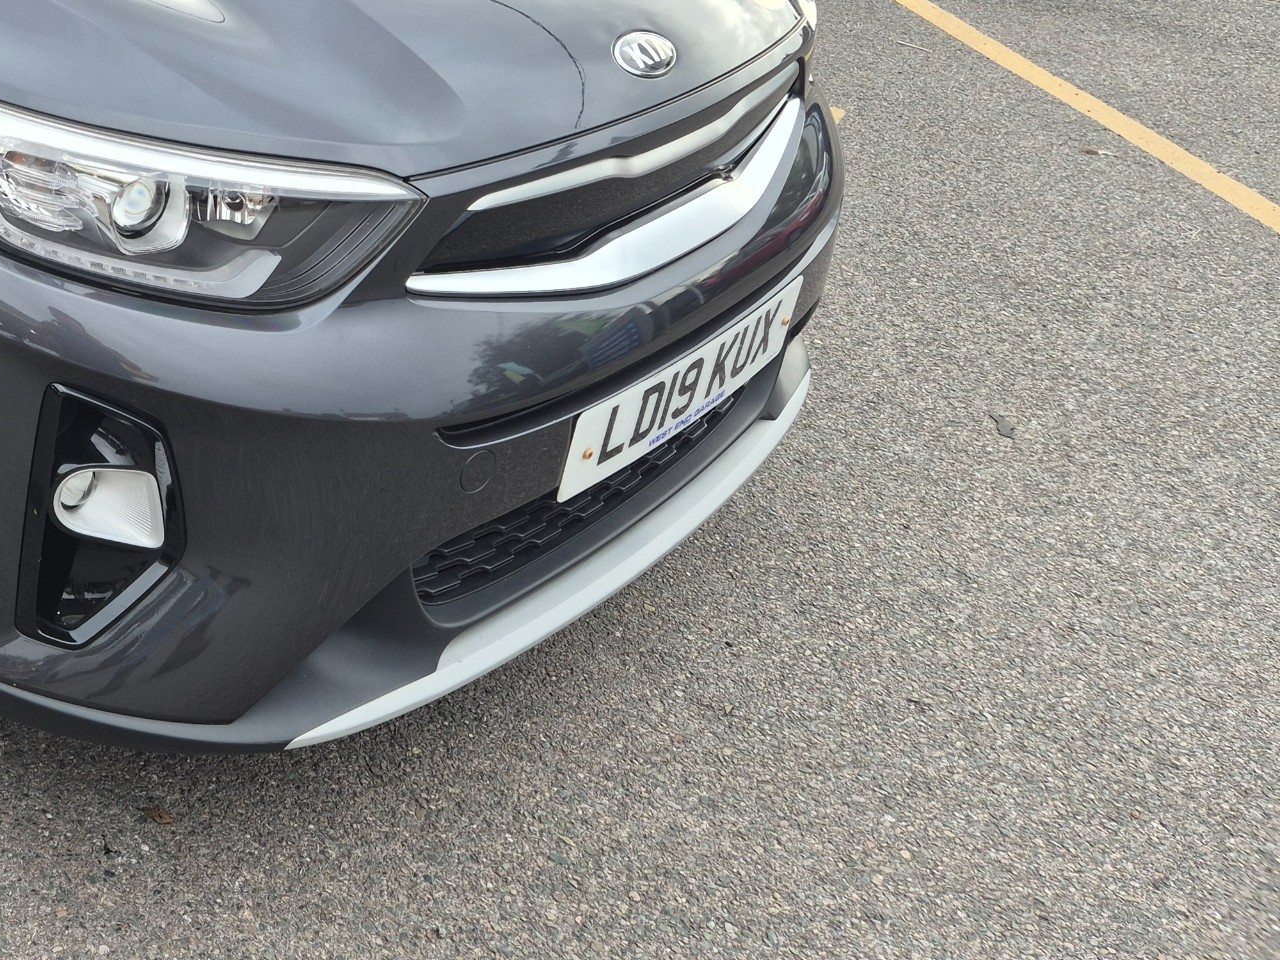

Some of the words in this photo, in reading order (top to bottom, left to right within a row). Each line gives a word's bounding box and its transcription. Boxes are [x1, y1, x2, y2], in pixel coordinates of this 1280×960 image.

[621, 38, 675, 70] KIA
[596, 357, 705, 466] LD19
[705, 299, 783, 399] KUX
[649, 427, 673, 447] WEST
[674, 414, 693, 431] END
[694, 390, 726, 418] GARAGE
